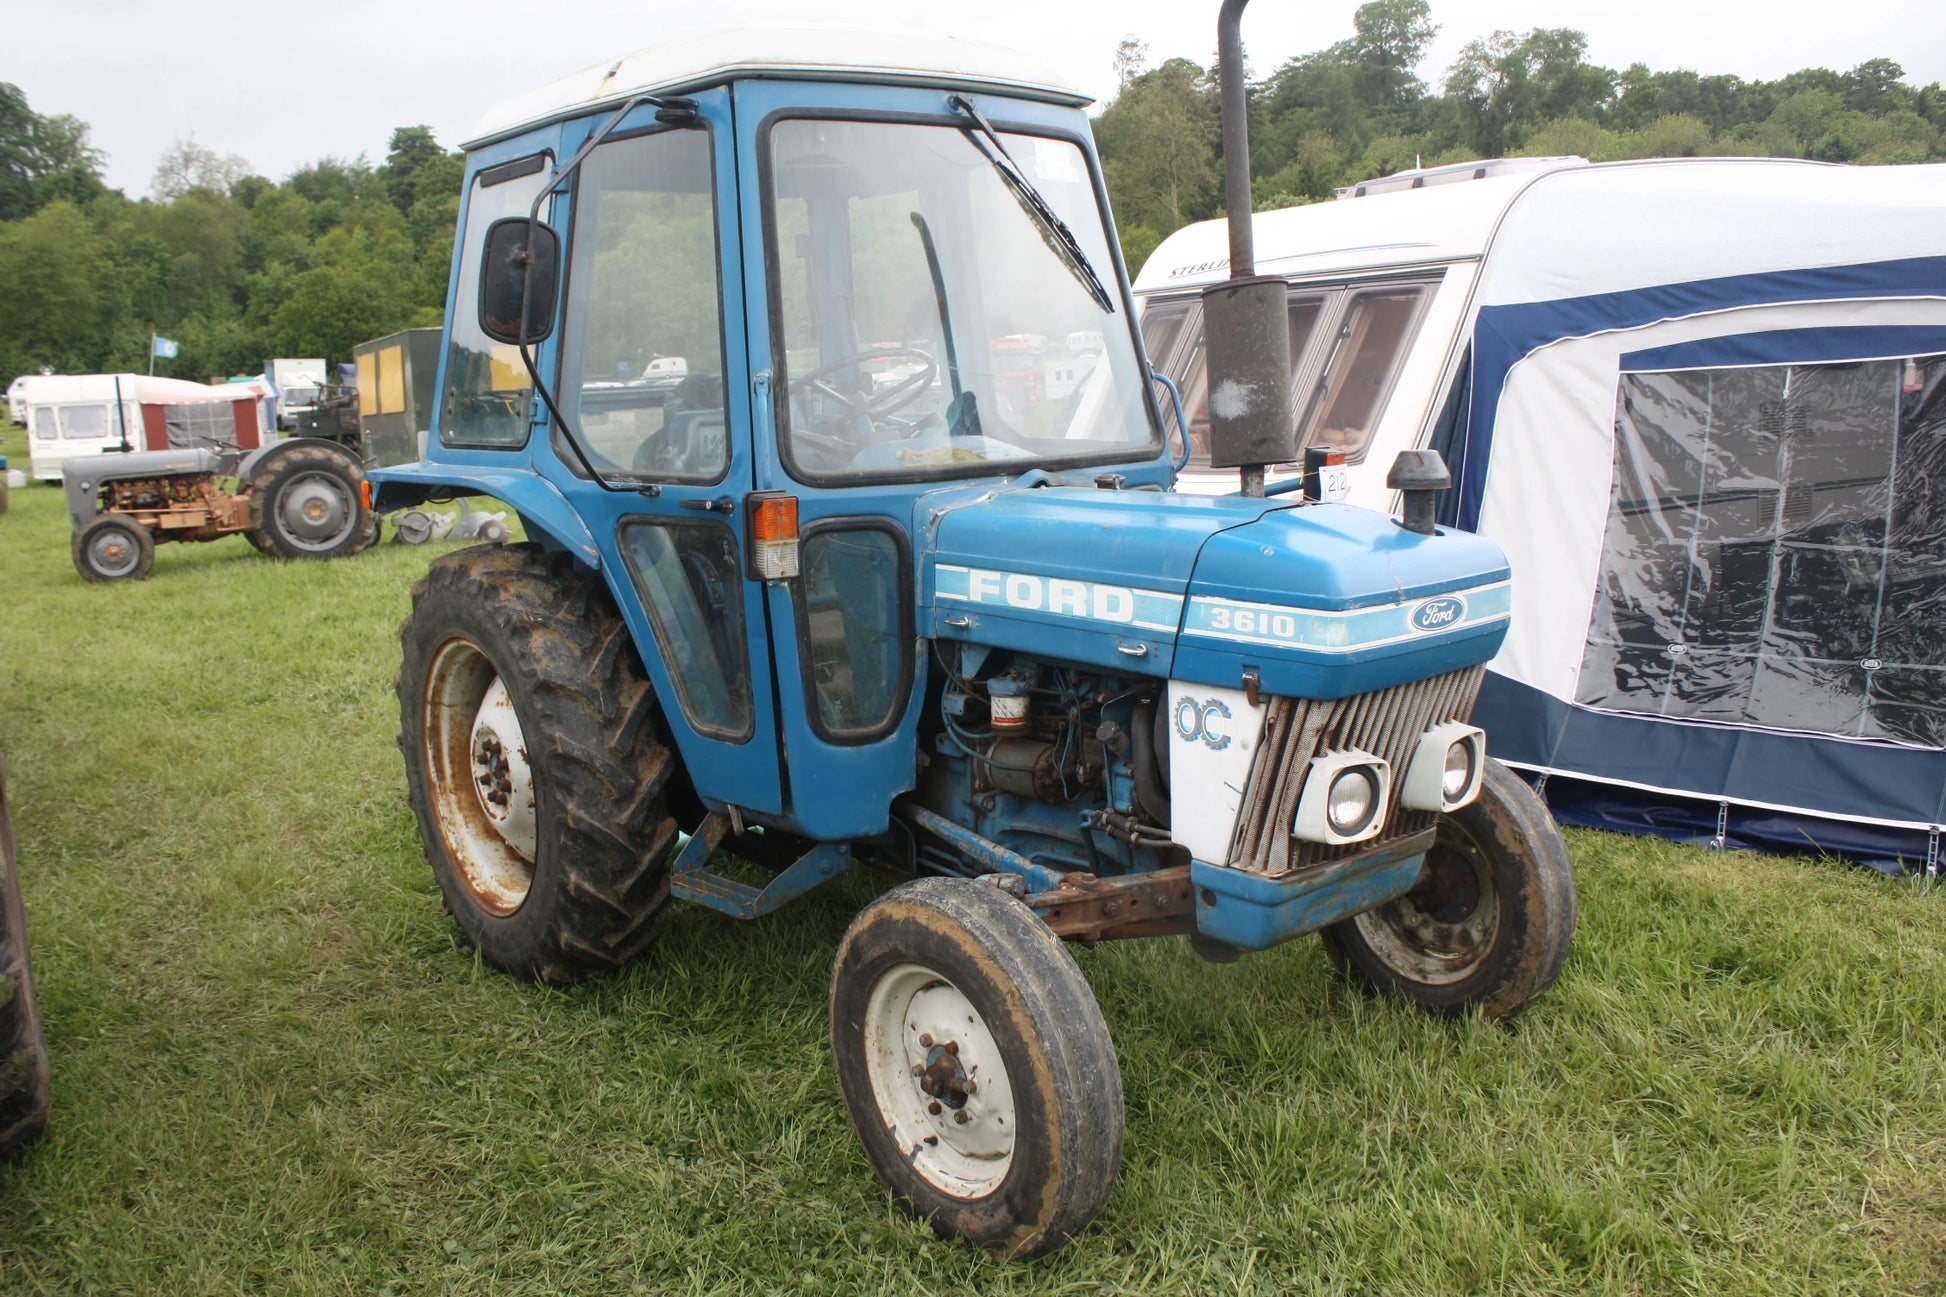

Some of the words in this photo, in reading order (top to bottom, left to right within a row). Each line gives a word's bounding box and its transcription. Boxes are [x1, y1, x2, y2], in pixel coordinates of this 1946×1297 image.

[1328, 472, 1346, 492] 212
[969, 569, 1134, 623] FORD
[1211, 607, 1295, 638] 3610
[1422, 601, 1457, 626] Ford
